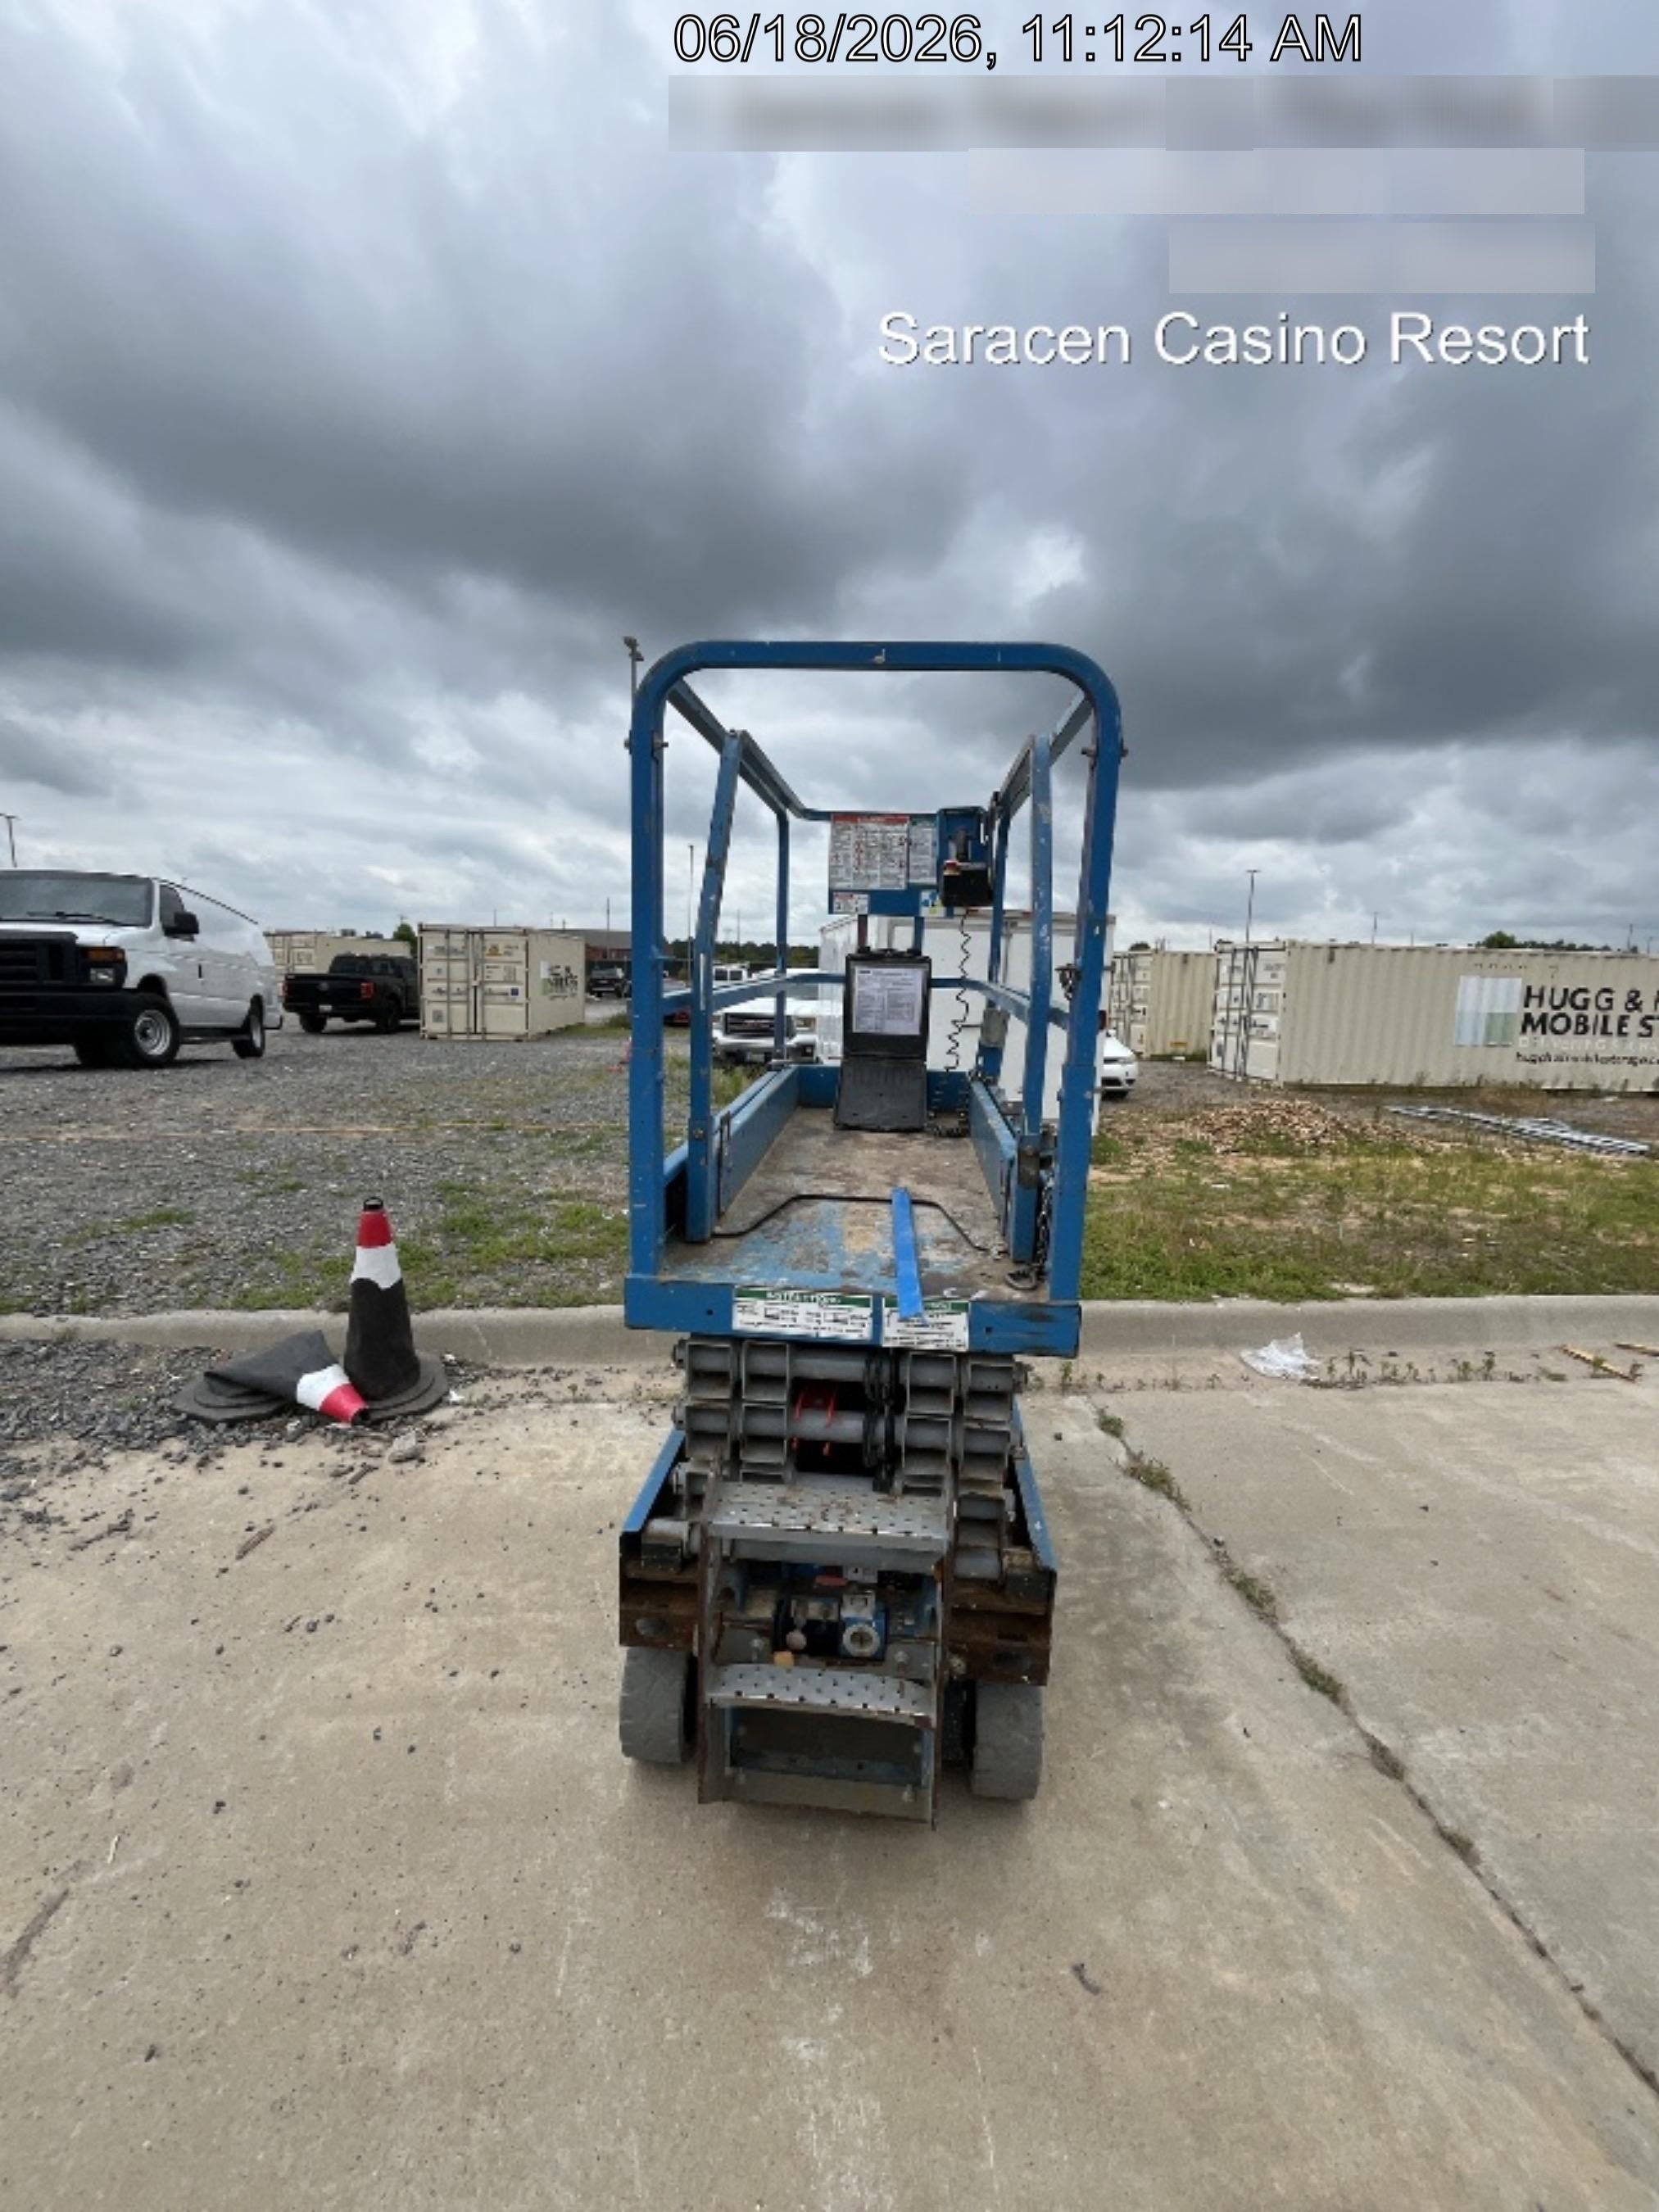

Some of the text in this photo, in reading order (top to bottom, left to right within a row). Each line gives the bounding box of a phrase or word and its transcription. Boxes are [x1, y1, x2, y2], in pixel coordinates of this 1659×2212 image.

[1524, 985, 1616, 1010] HUGG
[1625, 990, 1643, 1013] &
[1520, 1012, 1630, 1037] MOBILE
